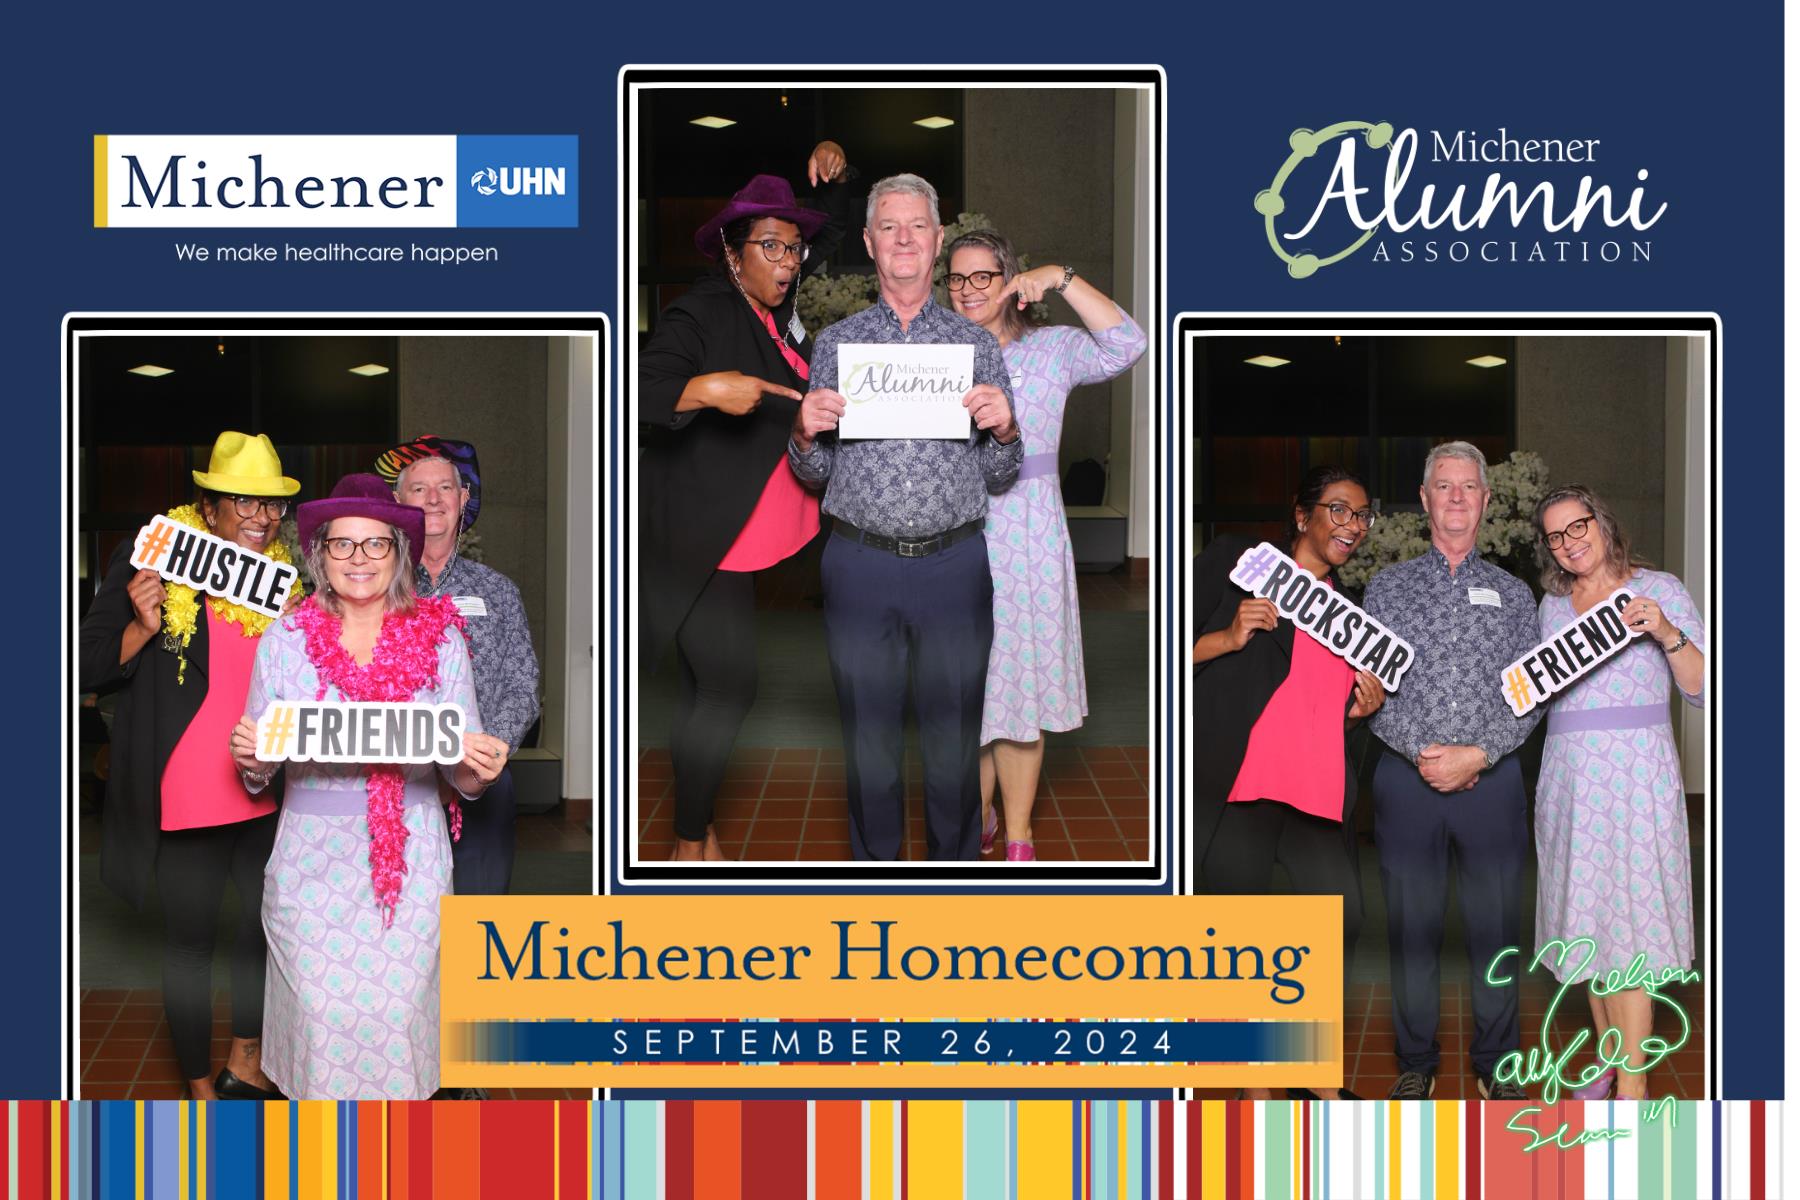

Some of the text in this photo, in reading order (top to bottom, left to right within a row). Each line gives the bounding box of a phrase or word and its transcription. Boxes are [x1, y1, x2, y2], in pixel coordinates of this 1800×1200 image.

[851, 363, 970, 395] Alumni
[897, 363, 950, 374] Michener
[137, 522, 292, 612] #HUSTLE
[1237, 549, 1409, 686] #ROCKSTAR
[264, 707, 460, 758] #FRIENDS
